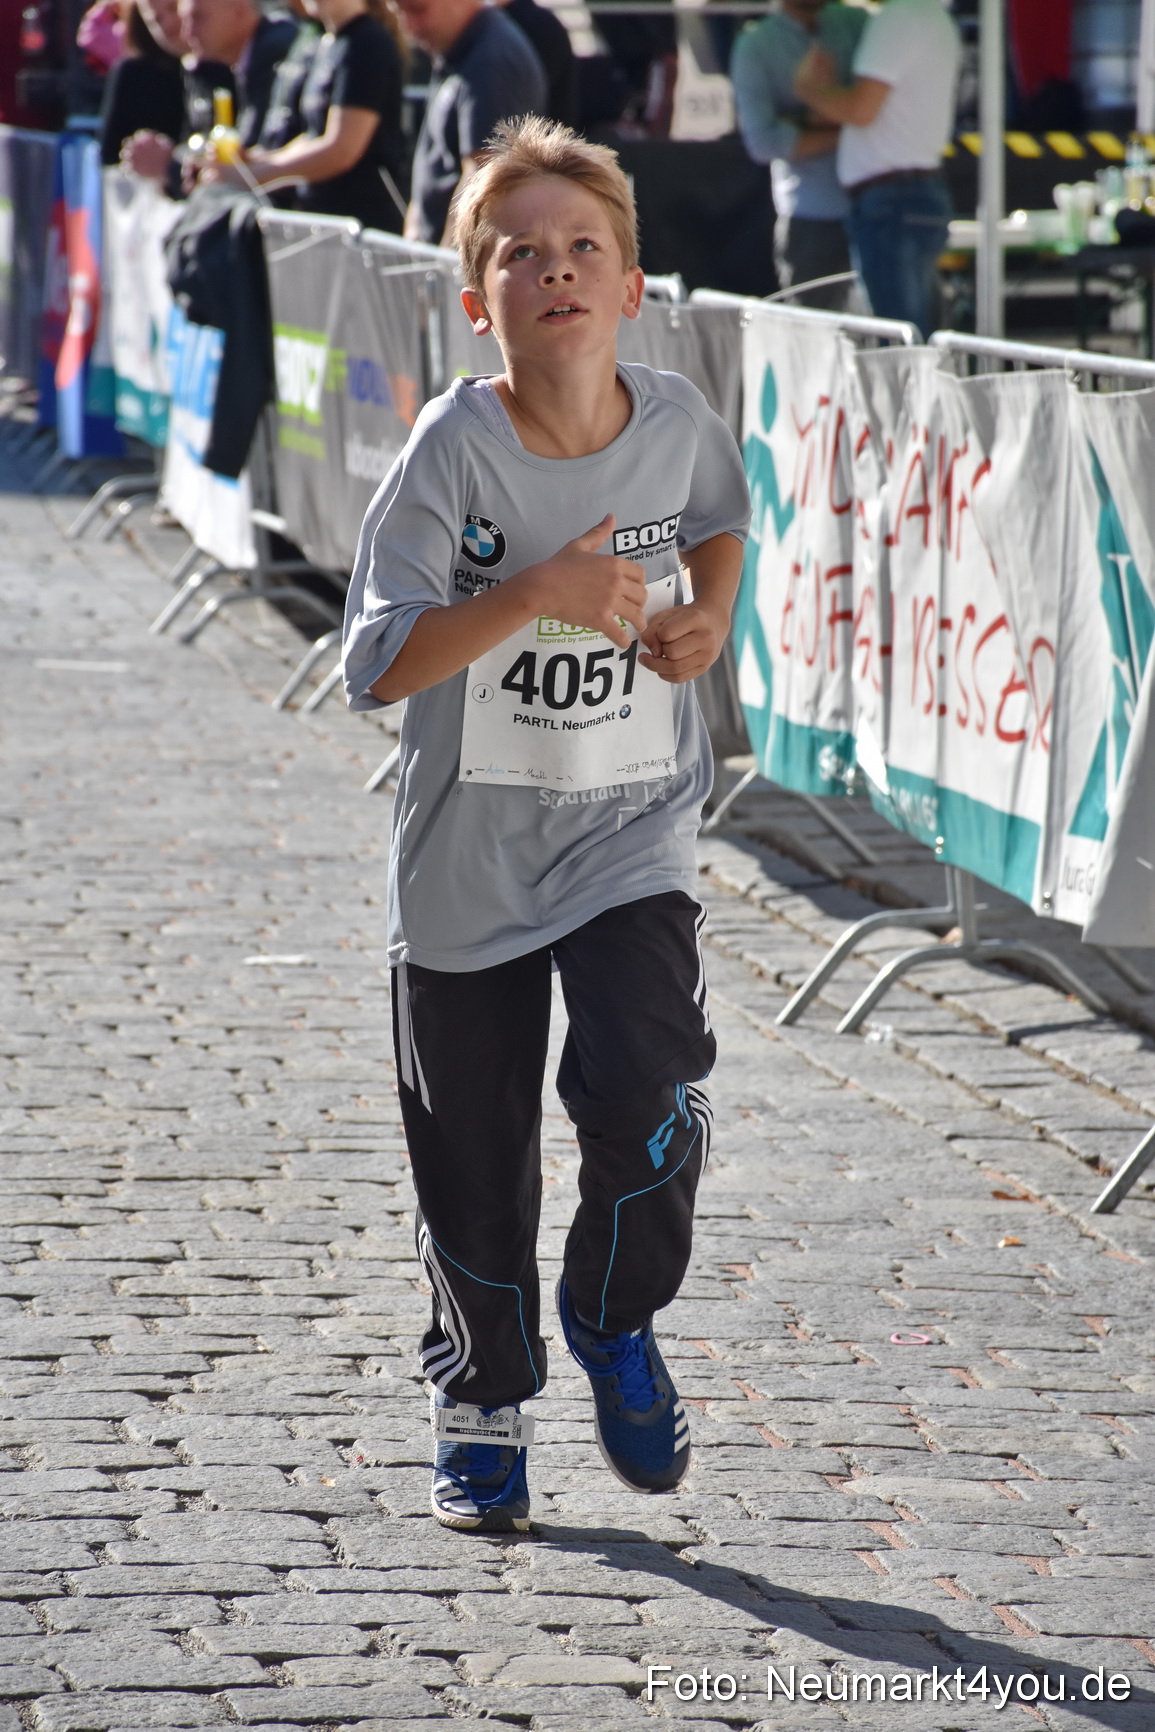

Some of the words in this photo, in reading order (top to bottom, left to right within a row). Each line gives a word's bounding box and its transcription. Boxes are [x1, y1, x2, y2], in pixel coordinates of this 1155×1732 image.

[613, 512, 682, 555] BOC
[536, 636, 566, 644] inspired
[578, 634, 599, 642] smart
[501, 640, 638, 710] 4051
[478, 688, 487, 699] J
[513, 713, 559, 731] PARTL
[561, 711, 616, 731] Neumarkt
[451, 1415, 469, 1424] 4051
